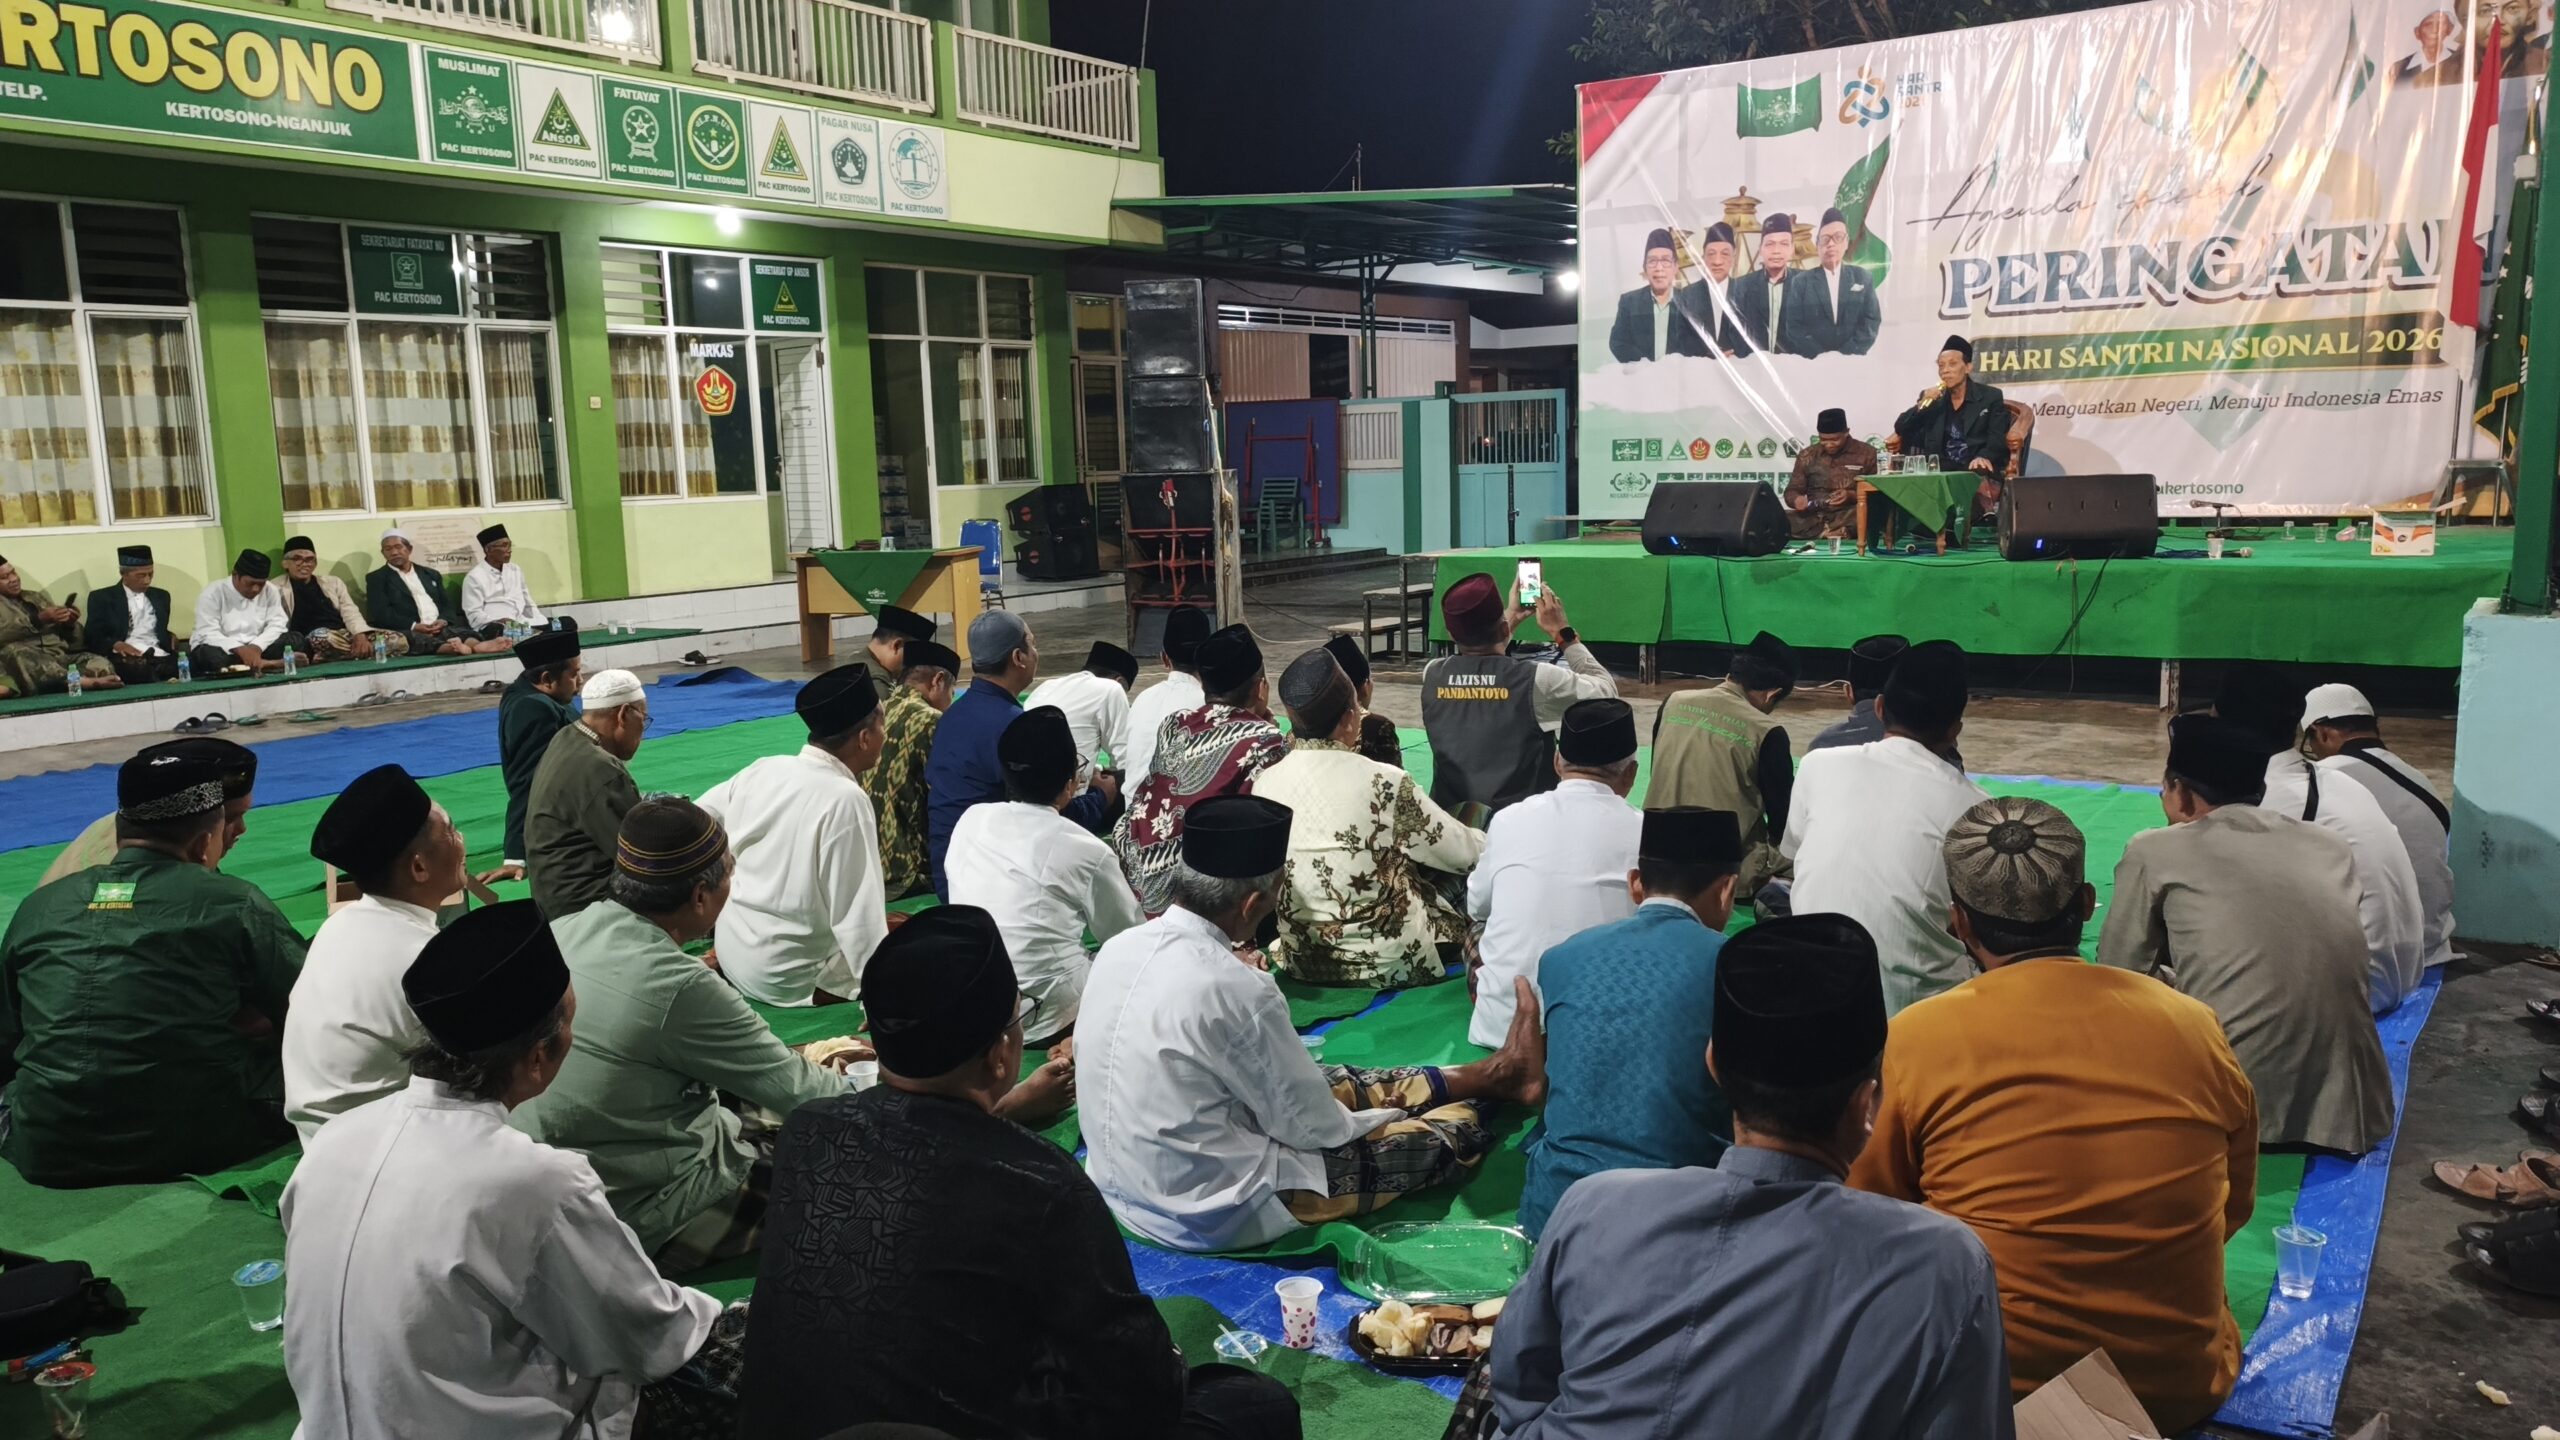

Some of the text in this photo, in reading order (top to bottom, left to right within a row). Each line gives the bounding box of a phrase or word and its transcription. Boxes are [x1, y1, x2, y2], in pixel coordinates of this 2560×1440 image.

[438, 57, 501, 77] MUSLIMAT
[613, 86, 661, 104] FATTAYAT
[165, 101, 353, 137] KERTOSONO-NGANJUK
[820, 115, 874, 134] PAGAR NUSA
[440, 142, 513, 159] PAC KERTOSONO
[529, 153, 597, 169] PAC KERTOSONO
[610, 162, 675, 178] PAC KERTOSONO
[687, 171, 746, 187] PAC KERTOSONO
[758, 180, 811, 195] PAC KERTOSONO
[825, 190, 879, 207] PAC KERTOSONO
[890, 201, 944, 215] PAC KERTOSONO
[361, 234, 445, 251] SEKRETARIAT FATAYAT NU
[755, 264, 786, 276] SEKRETARIAT
[374, 291, 442, 304] PAC KERTOSONO
[763, 315, 810, 325] PAC KERTOSONO
[690, 343, 734, 358] MARKAS
[1978, 327, 2443, 373] HARI SANTRI NASIONAL 2026
[2032, 388, 2444, 419] Menguatkan Negeri, Menuju Indonesia Emas
[1448, 675, 1496, 685] LAZISNU
[1437, 687, 1509, 699] PANDANTOYO
